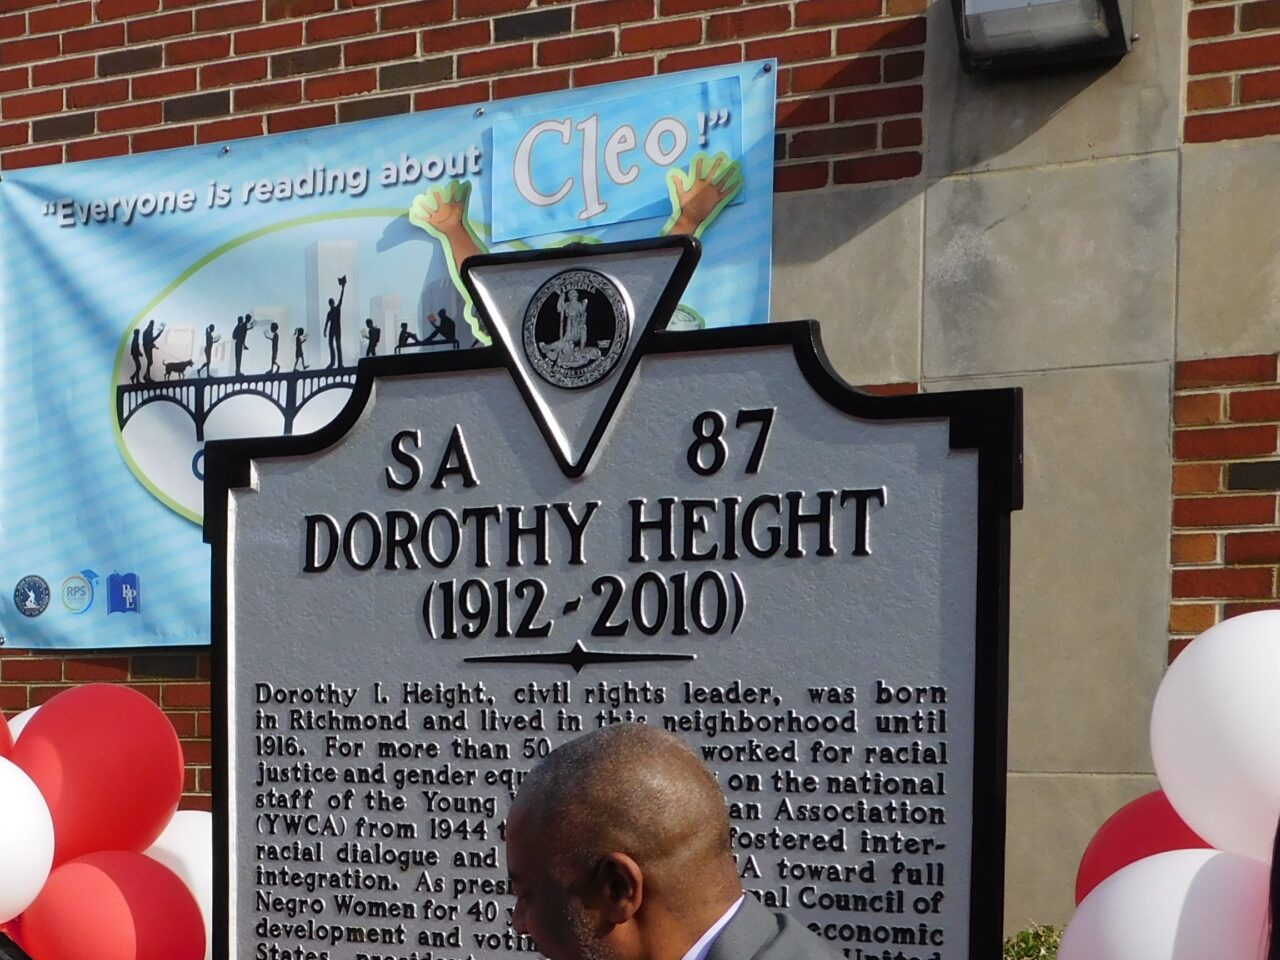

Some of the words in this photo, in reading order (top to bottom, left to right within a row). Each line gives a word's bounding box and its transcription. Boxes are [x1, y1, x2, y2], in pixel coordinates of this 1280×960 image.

[206, 178, 232, 209] is
[242, 164, 370, 204] reading
[379, 143, 482, 187] about
[686, 407, 777, 476] 87
[303, 501, 600, 573] DOROTHY
[627, 486, 887, 563] HEIGHT
[66, 586, 87, 597] RPS
[255, 682, 358, 707] Dorothy
[403, 681, 496, 708] Height,
[514, 681, 570, 704] civil
[585, 681, 666, 709] rights
[684, 680, 782, 706] leader,
[808, 686, 857, 703] was
[876, 680, 947, 703] born
[255, 709, 278, 729] in
[290, 709, 409, 730] Richmond
[423, 711, 468, 731] and
[480, 709, 545, 731] lived
[558, 709, 582, 731] in
[663, 710, 858, 737] neighborhood
[876, 710, 948, 733] until
[255, 735, 307, 757] 1916.
[325, 735, 364, 757] For
[378, 739, 440, 758] more
[451, 737, 510, 759] than
[523, 737, 552, 758] 50
[700, 740, 799, 763] worked
[811, 741, 853, 763] for
[866, 742, 948, 765] racial
[255, 761, 337, 786] justice
[343, 762, 387, 784] and
[394, 763, 476, 790] gender
[728, 772, 762, 791] on
[771, 771, 818, 793] the
[827, 771, 945, 795] national
[255, 789, 315, 808] staff
[328, 789, 355, 809] of
[365, 791, 407, 811] the
[421, 791, 497, 818] Young
[774, 798, 946, 824] Association
[255, 814, 347, 837] (YWCA)
[356, 818, 417, 839] from
[430, 818, 488, 840] 1944
[861, 830, 946, 854] inter-
[255, 841, 323, 862] racial
[337, 842, 440, 871] dialogue
[453, 848, 498, 868] and
[777, 857, 875, 883] toward
[892, 861, 945, 886] full
[255, 865, 400, 893] integration.
[415, 871, 445, 893] As
[798, 886, 904, 913] Council
[913, 891, 944, 914] of
[255, 891, 326, 917] Negro
[333, 895, 417, 919] Women
[423, 900, 459, 920] for
[467, 900, 498, 922] 40
[255, 919, 407, 945] development
[418, 926, 462, 949] and
[474, 928, 538, 952] votin
